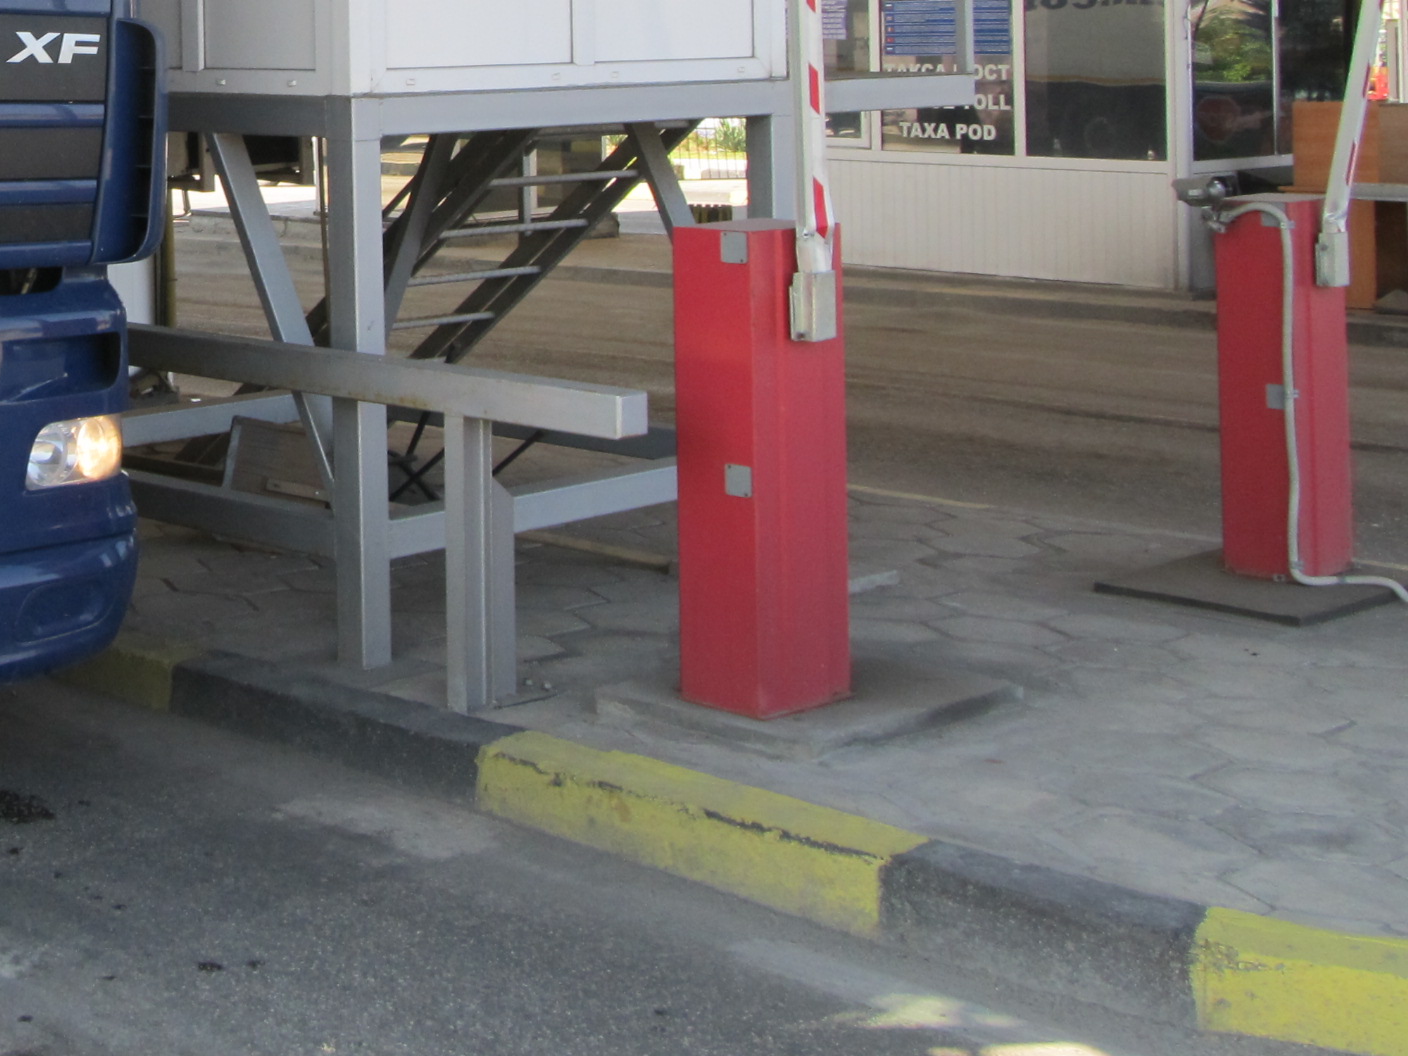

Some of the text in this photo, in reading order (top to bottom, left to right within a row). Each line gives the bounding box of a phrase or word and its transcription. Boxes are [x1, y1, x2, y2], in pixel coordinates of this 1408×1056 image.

[6, 31, 101, 64] XF
[963, 94, 1011, 111] OLL
[899, 121, 997, 141] TAXA POD
